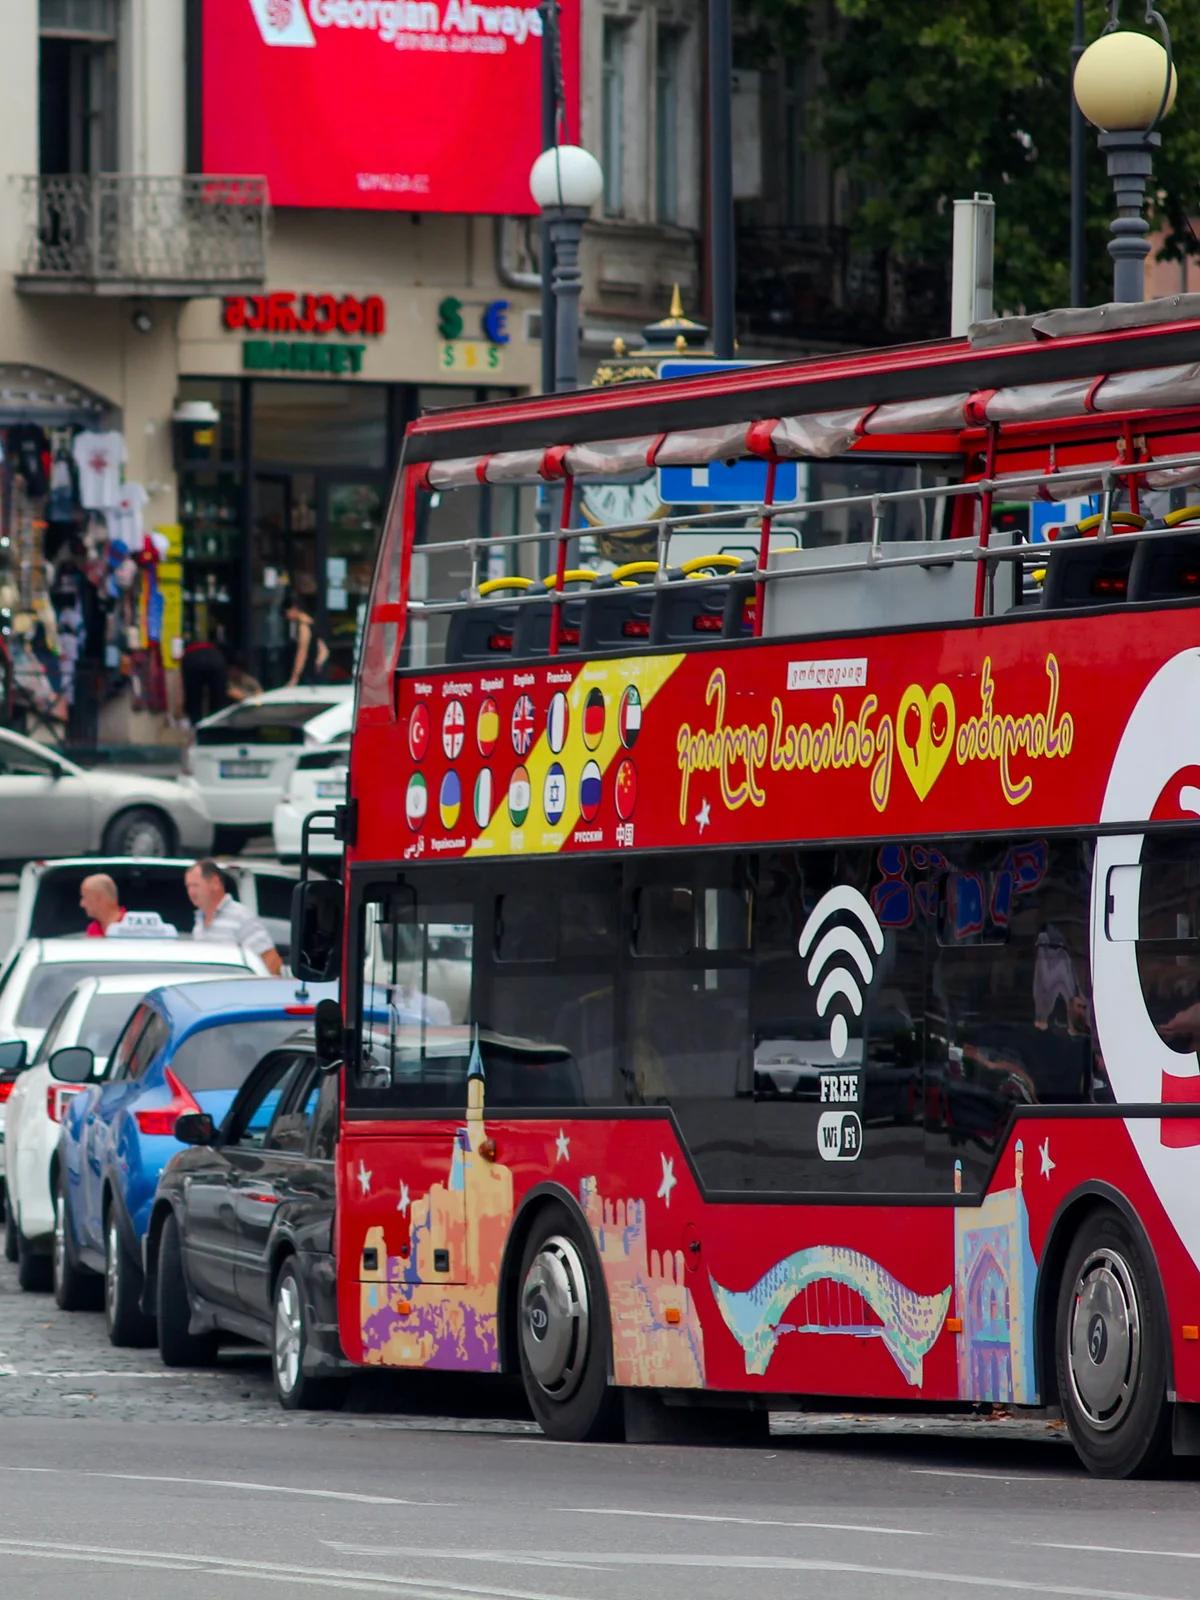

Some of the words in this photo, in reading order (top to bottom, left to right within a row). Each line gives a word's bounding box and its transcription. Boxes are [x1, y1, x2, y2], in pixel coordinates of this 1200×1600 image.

[956, 652, 1074, 806] თბილისი
[127, 916, 158, 926] TAXI
[820, 1075, 858, 1102] FREE
